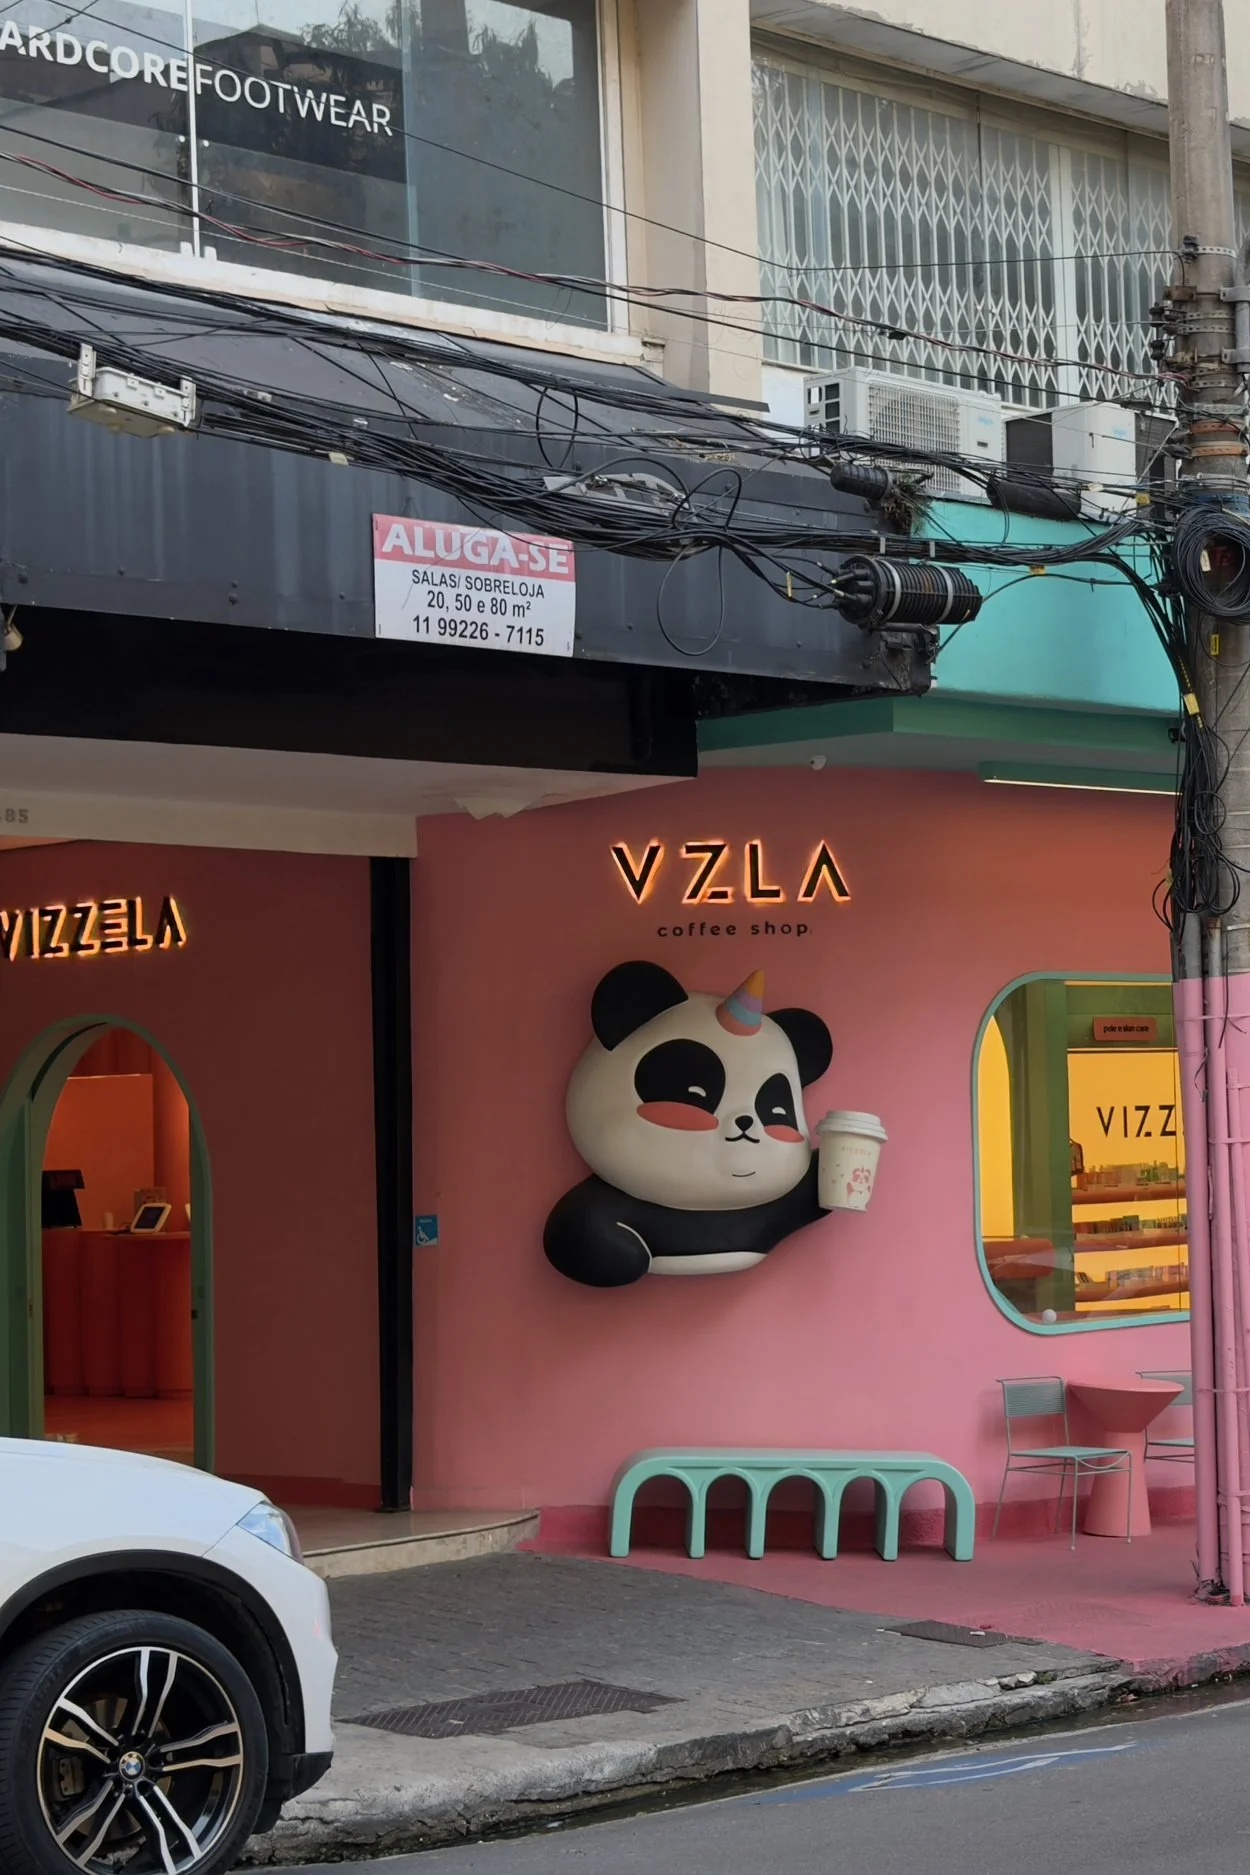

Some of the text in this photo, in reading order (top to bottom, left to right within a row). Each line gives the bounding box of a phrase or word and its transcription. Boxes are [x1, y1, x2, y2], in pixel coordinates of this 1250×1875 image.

[381, 523, 569, 574] ALUGA-SE
[411, 569, 545, 599] SALAS/ SOBRELOJA
[427, 590, 449, 613] 20,
[455, 593, 472, 612] 50
[477, 599, 485, 613] e
[490, 597, 507, 616] 80
[413, 615, 430, 634] 11
[437, 617, 489, 641] 99226
[506, 625, 544, 647] 7115
[0, 808, 29, 824] 85
[609, 838, 851, 904] VZLA
[0, 892, 187, 962] VIZZELA
[657, 921, 809, 938] coffee shop
[1096, 1104, 1184, 1138] VIZZ
